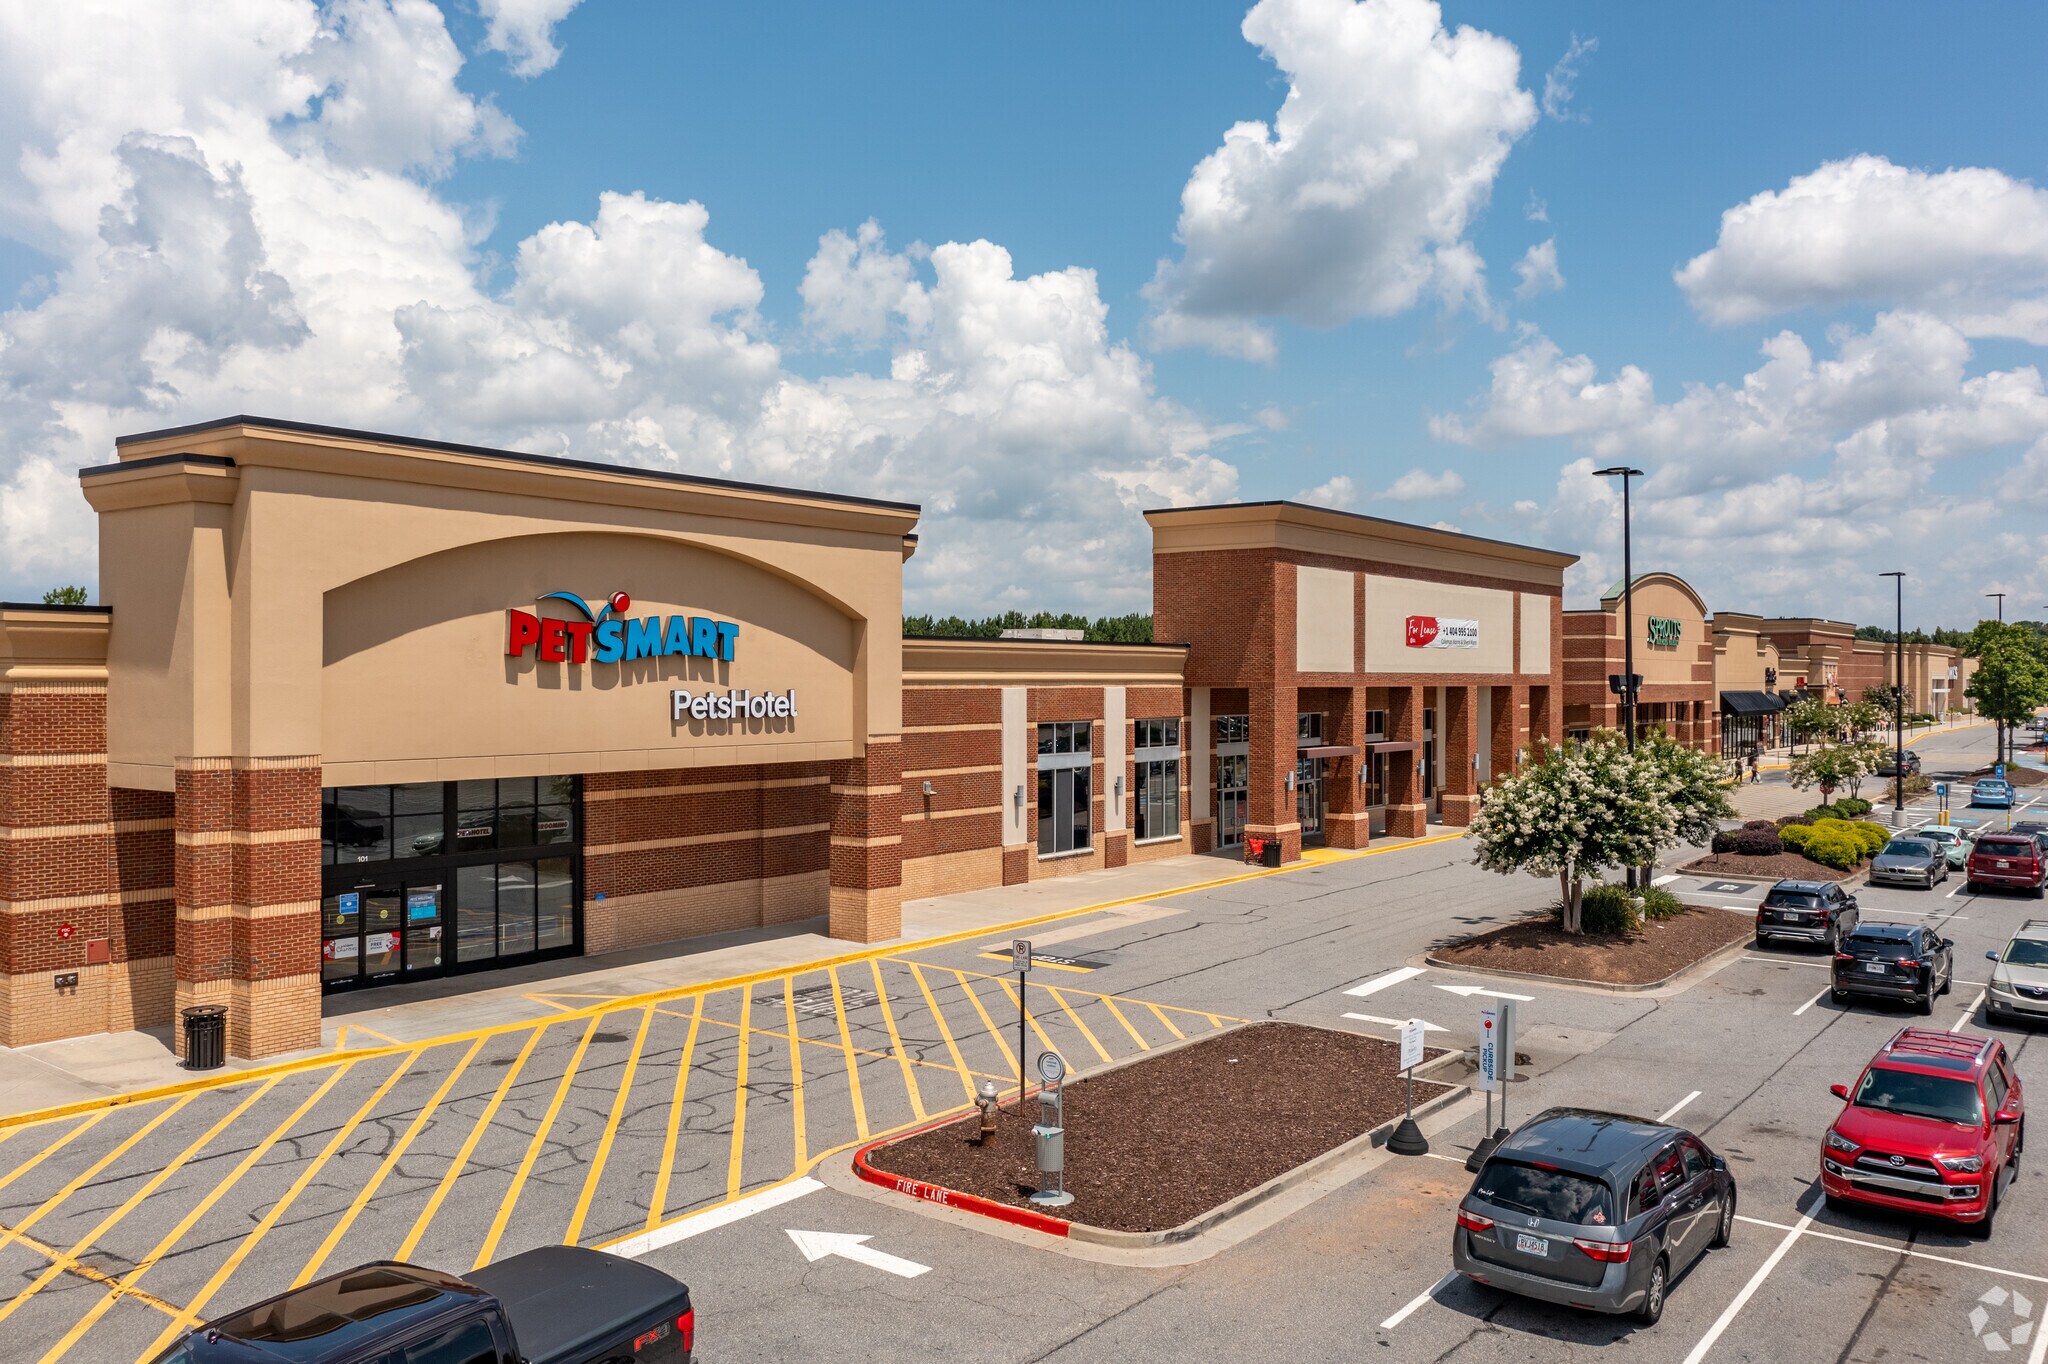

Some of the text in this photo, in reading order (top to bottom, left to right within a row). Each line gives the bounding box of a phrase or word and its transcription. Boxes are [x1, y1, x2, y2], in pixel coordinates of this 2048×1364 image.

[1408, 619, 1437, 638] For Lease
[1449, 627, 1458, 636] 404
[1648, 616, 1681, 643] SPROUTS
[670, 689, 798, 721] PetsHotel
[357, 855, 368, 863] 101
[896, 1179, 949, 1204] FIRE LANE
[633, 1321, 671, 1353] FX4
